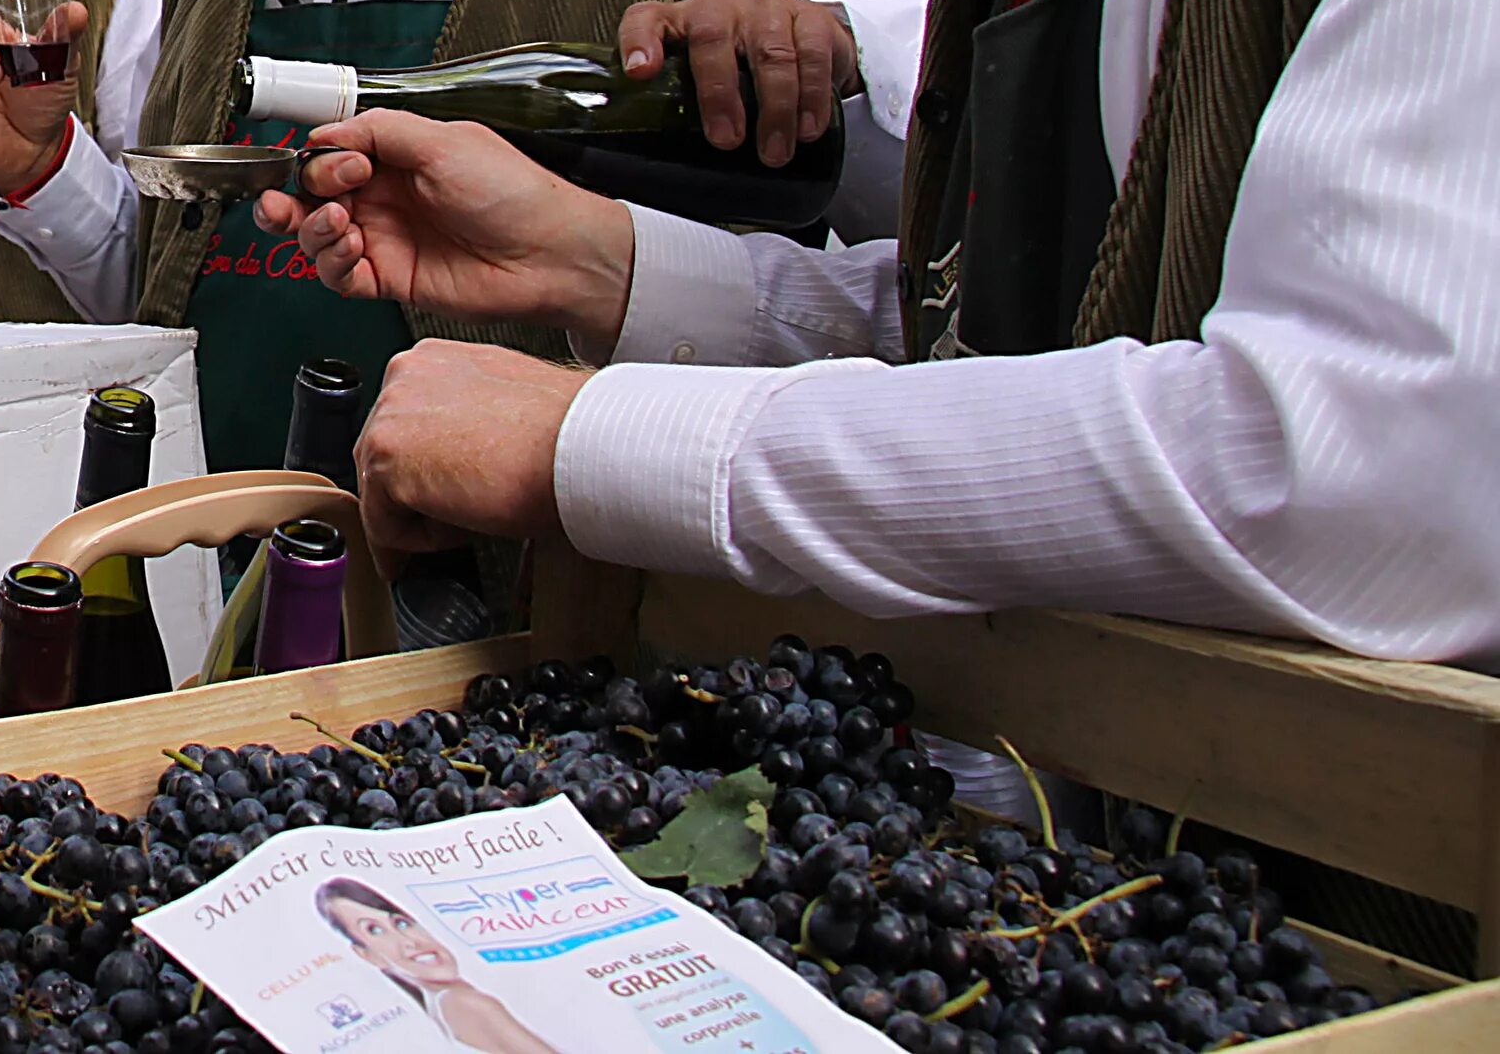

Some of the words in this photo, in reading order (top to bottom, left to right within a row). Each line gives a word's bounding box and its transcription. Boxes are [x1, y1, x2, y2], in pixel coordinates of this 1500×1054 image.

[194, 852, 309, 931] Mincir
[320, 839, 383, 868] c'est
[387, 842, 461, 875] super
[463, 821, 545, 869] facile
[467, 880, 567, 913] hyper
[586, 960, 628, 980] Bon
[608, 954, 718, 997] GRATUIT
[653, 1011, 688, 1030] une
[689, 989, 748, 1019] analyse
[682, 1009, 763, 1045] corporelle
